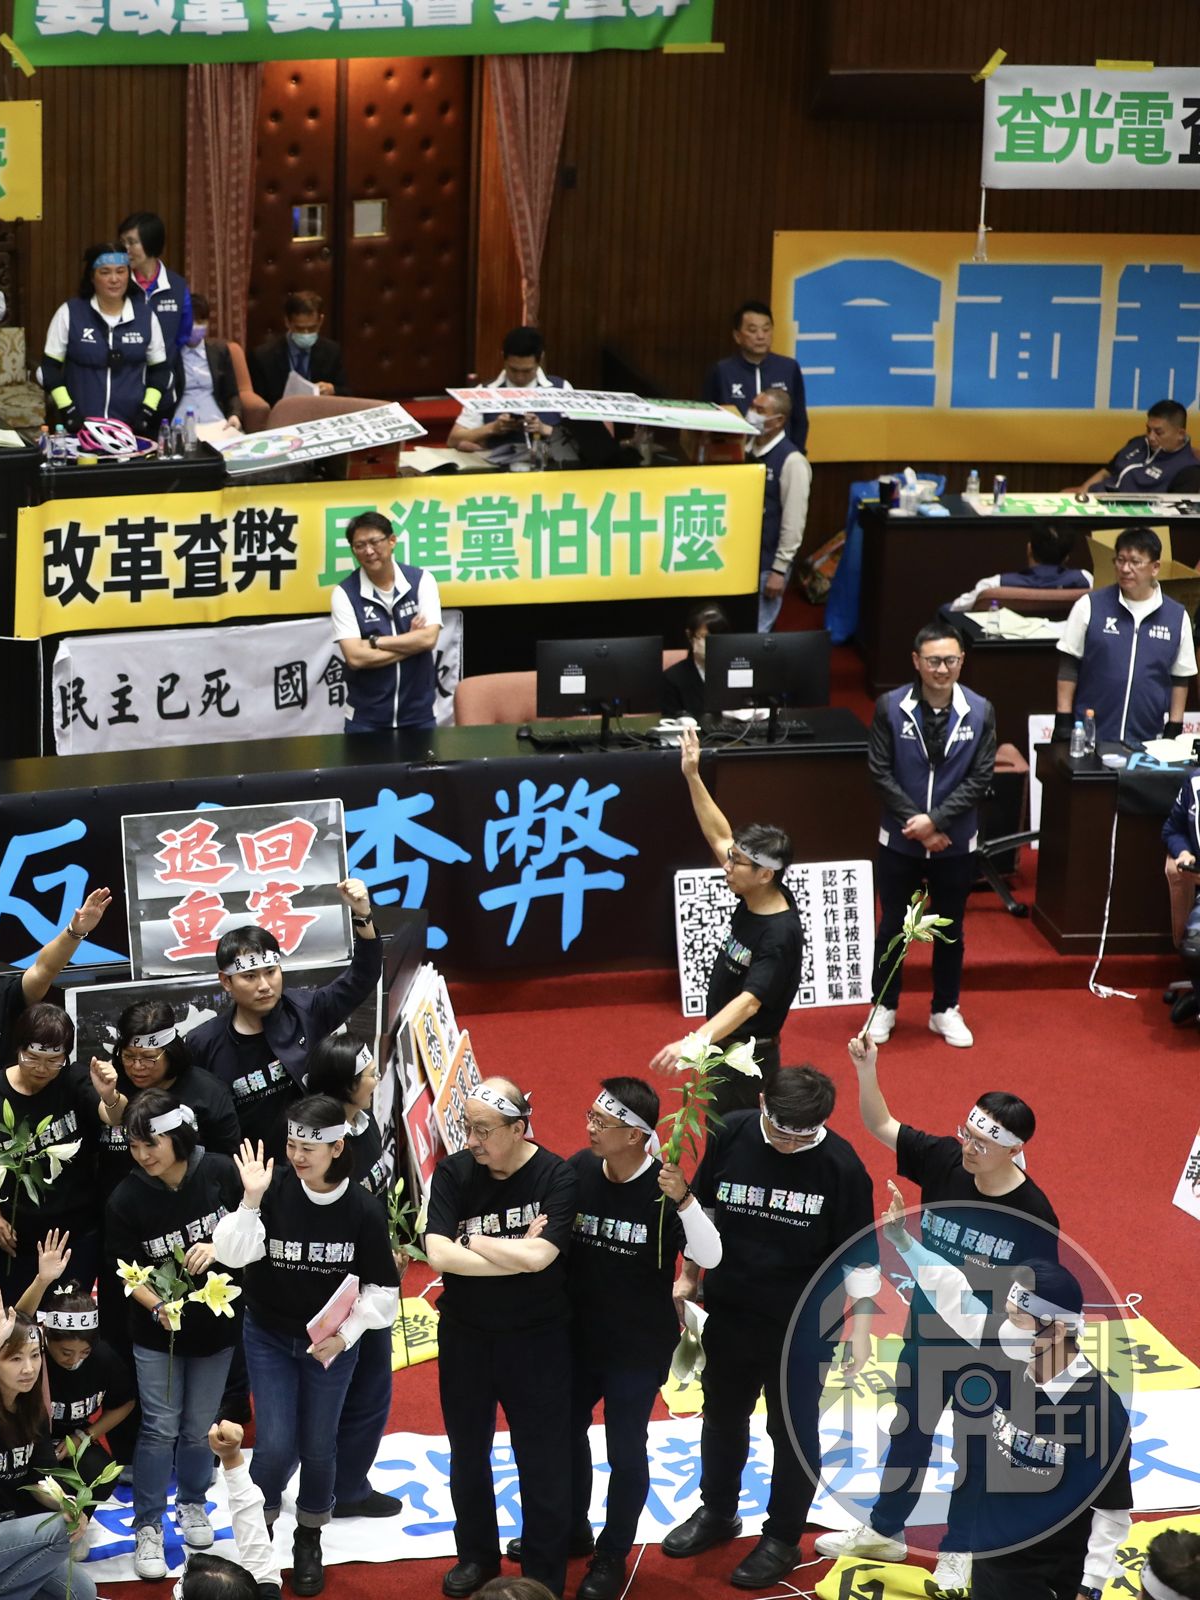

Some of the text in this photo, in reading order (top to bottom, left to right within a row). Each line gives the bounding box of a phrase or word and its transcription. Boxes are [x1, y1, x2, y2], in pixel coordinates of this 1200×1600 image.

[994, 88, 1174, 165] 查光電
[43, 507, 298, 607] 改革查弊
[59, 668, 240, 730] 民主已死
[154, 817, 318, 886] 退回
[821, 869, 844, 1001] 認知作戰給欺騙
[842, 868, 863, 999] 不要再被民進黨
[716, 1181, 825, 1215] 反黑箱 反擴權
